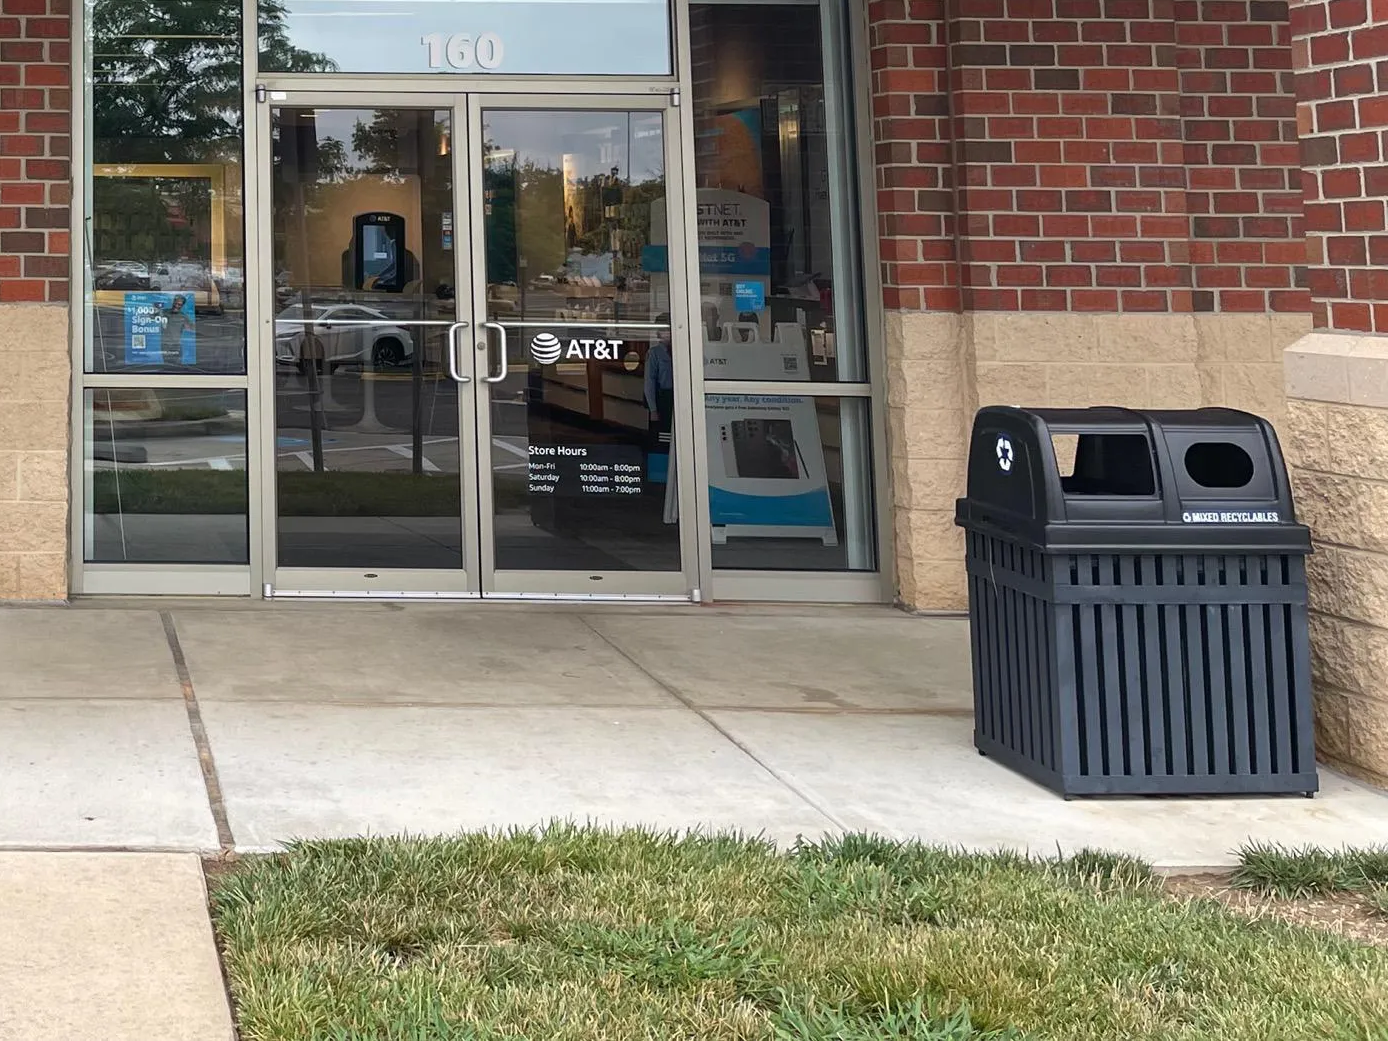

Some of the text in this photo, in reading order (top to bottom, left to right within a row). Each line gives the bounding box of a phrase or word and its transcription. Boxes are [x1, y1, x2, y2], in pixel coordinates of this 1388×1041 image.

[420, 32, 505, 69] 160
[131, 315, 168, 326] Sign-On
[131, 325, 160, 334] Bonus
[566, 339, 624, 360] AT&T
[528, 446, 587, 456] Store Hours
[528, 462, 555, 470] Mon-Fri
[580, 463, 608, 471] 10:00am
[614, 464, 641, 472] 8:00pm
[529, 473, 559, 482] Saturday
[580, 474, 609, 482] 10:00am
[614, 475, 641, 483] 8:00pm
[529, 484, 554, 492] Sunday
[582, 485, 609, 493] 11:00am
[615, 486, 641, 494] 7:00pm
[1192, 512, 1279, 522] MIXED RECYCLABLES
